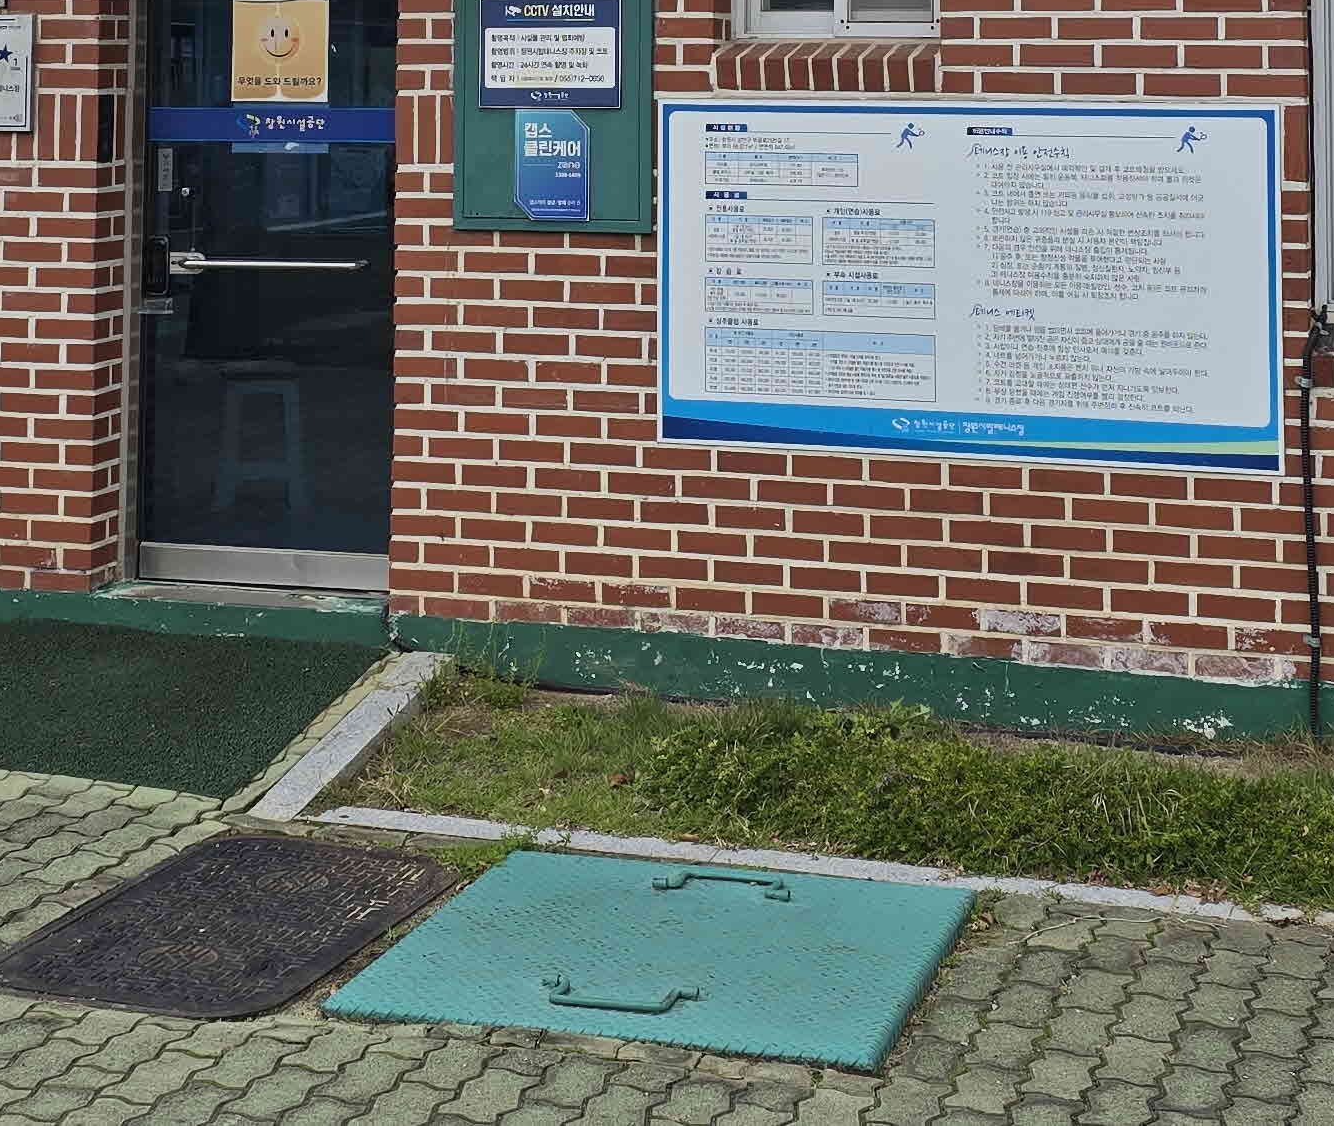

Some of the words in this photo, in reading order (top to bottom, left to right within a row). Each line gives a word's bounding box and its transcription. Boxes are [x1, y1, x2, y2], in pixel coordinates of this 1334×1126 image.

[523, 4, 550, 17] CCTV
[551, 4, 596, 17] 설치안내
[283, 76, 323, 87] 드릴까요?
[265, 115, 326, 133] 창원시설공단
[523, 122, 553, 139] 캡스
[523, 140, 582, 158] 클린케어
